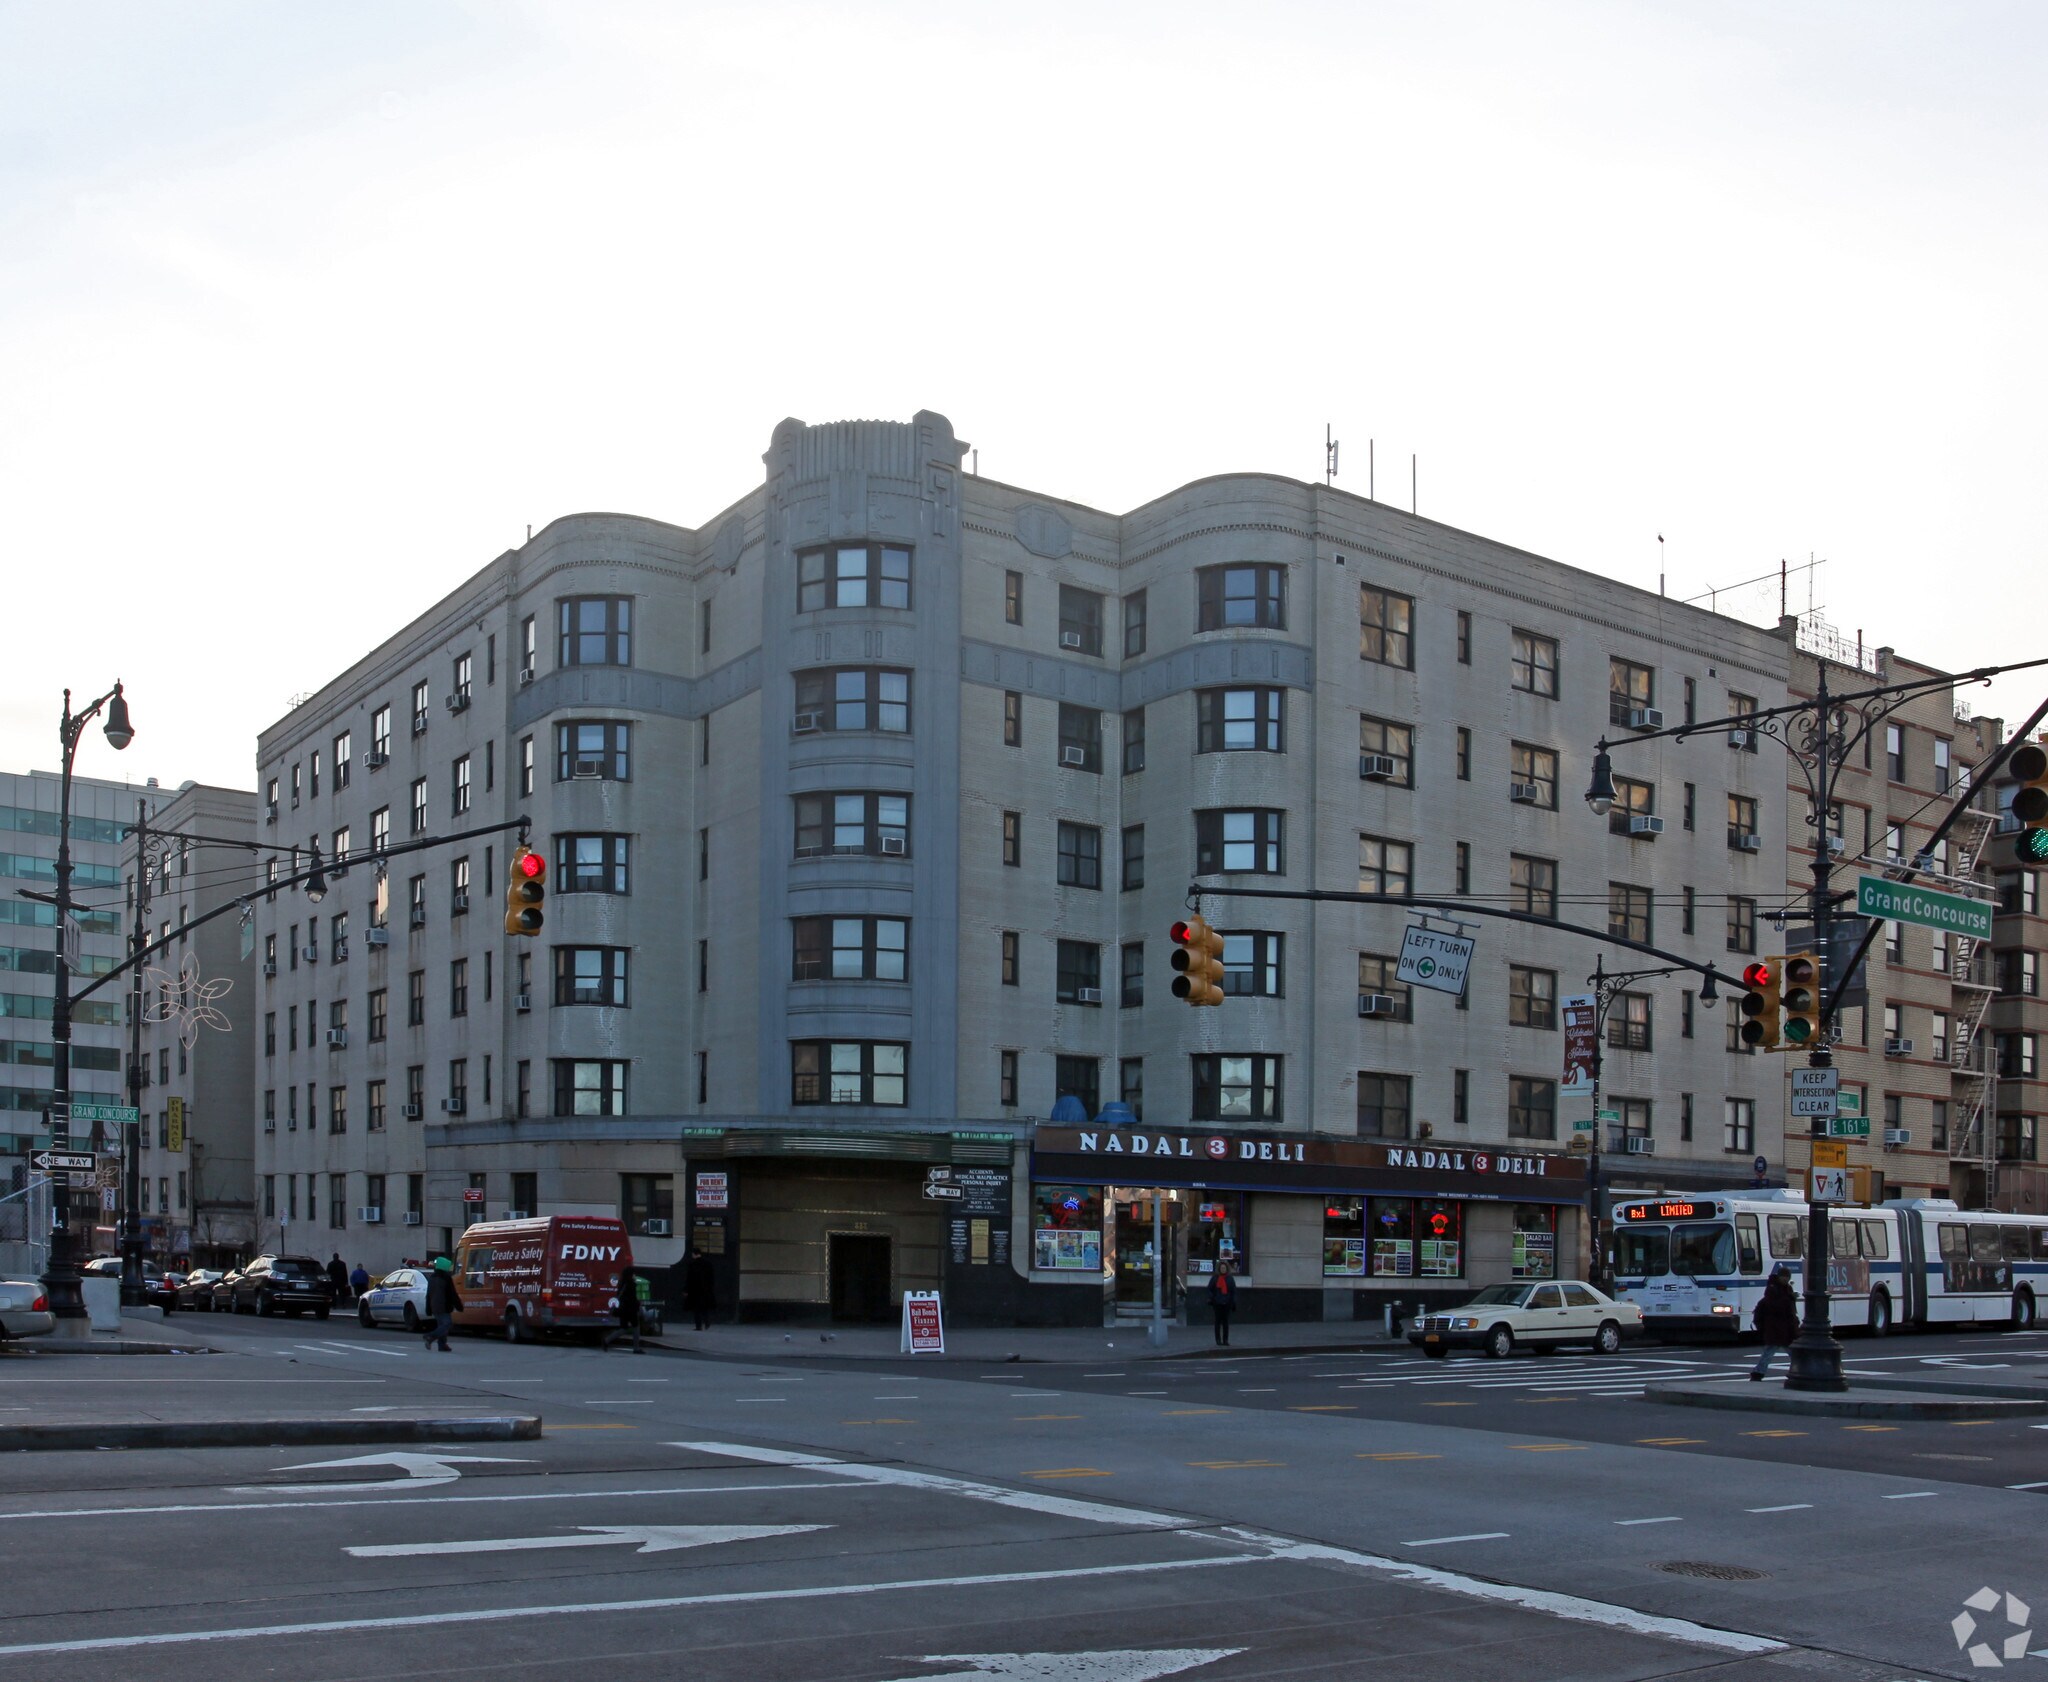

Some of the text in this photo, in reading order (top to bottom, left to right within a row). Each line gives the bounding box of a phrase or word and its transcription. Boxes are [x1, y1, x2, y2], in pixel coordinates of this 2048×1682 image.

[1864, 886, 1988, 930] Grand Concourse
[1408, 934, 1468, 957] LEFT TURN
[1402, 957, 1463, 980] ON ONLY
[1802, 1074, 1827, 1084] KEEP
[1794, 1088, 1836, 1097] INTERSECTION
[74, 1106, 137, 1120] GRAND CONCOURSE
[1798, 1102, 1830, 1112] CLEAR
[1832, 1121, 1837, 1133] E
[1842, 1121, 1858, 1133] 161
[1080, 1132, 1304, 1162] NADAL 3 DELI
[40, 1156, 88, 1166] ONE WAY
[1387, 1148, 1546, 1176] NADAL 3 DELI
[1630, 1204, 1693, 1218] Bx1 LIMITED
[492, 1250, 514, 1260] Create
[521, 1248, 544, 1261] Safety
[561, 1244, 621, 1261] FDNY
[1827, 1266, 1847, 1286] IRLS
[502, 1282, 542, 1296] Your Family
